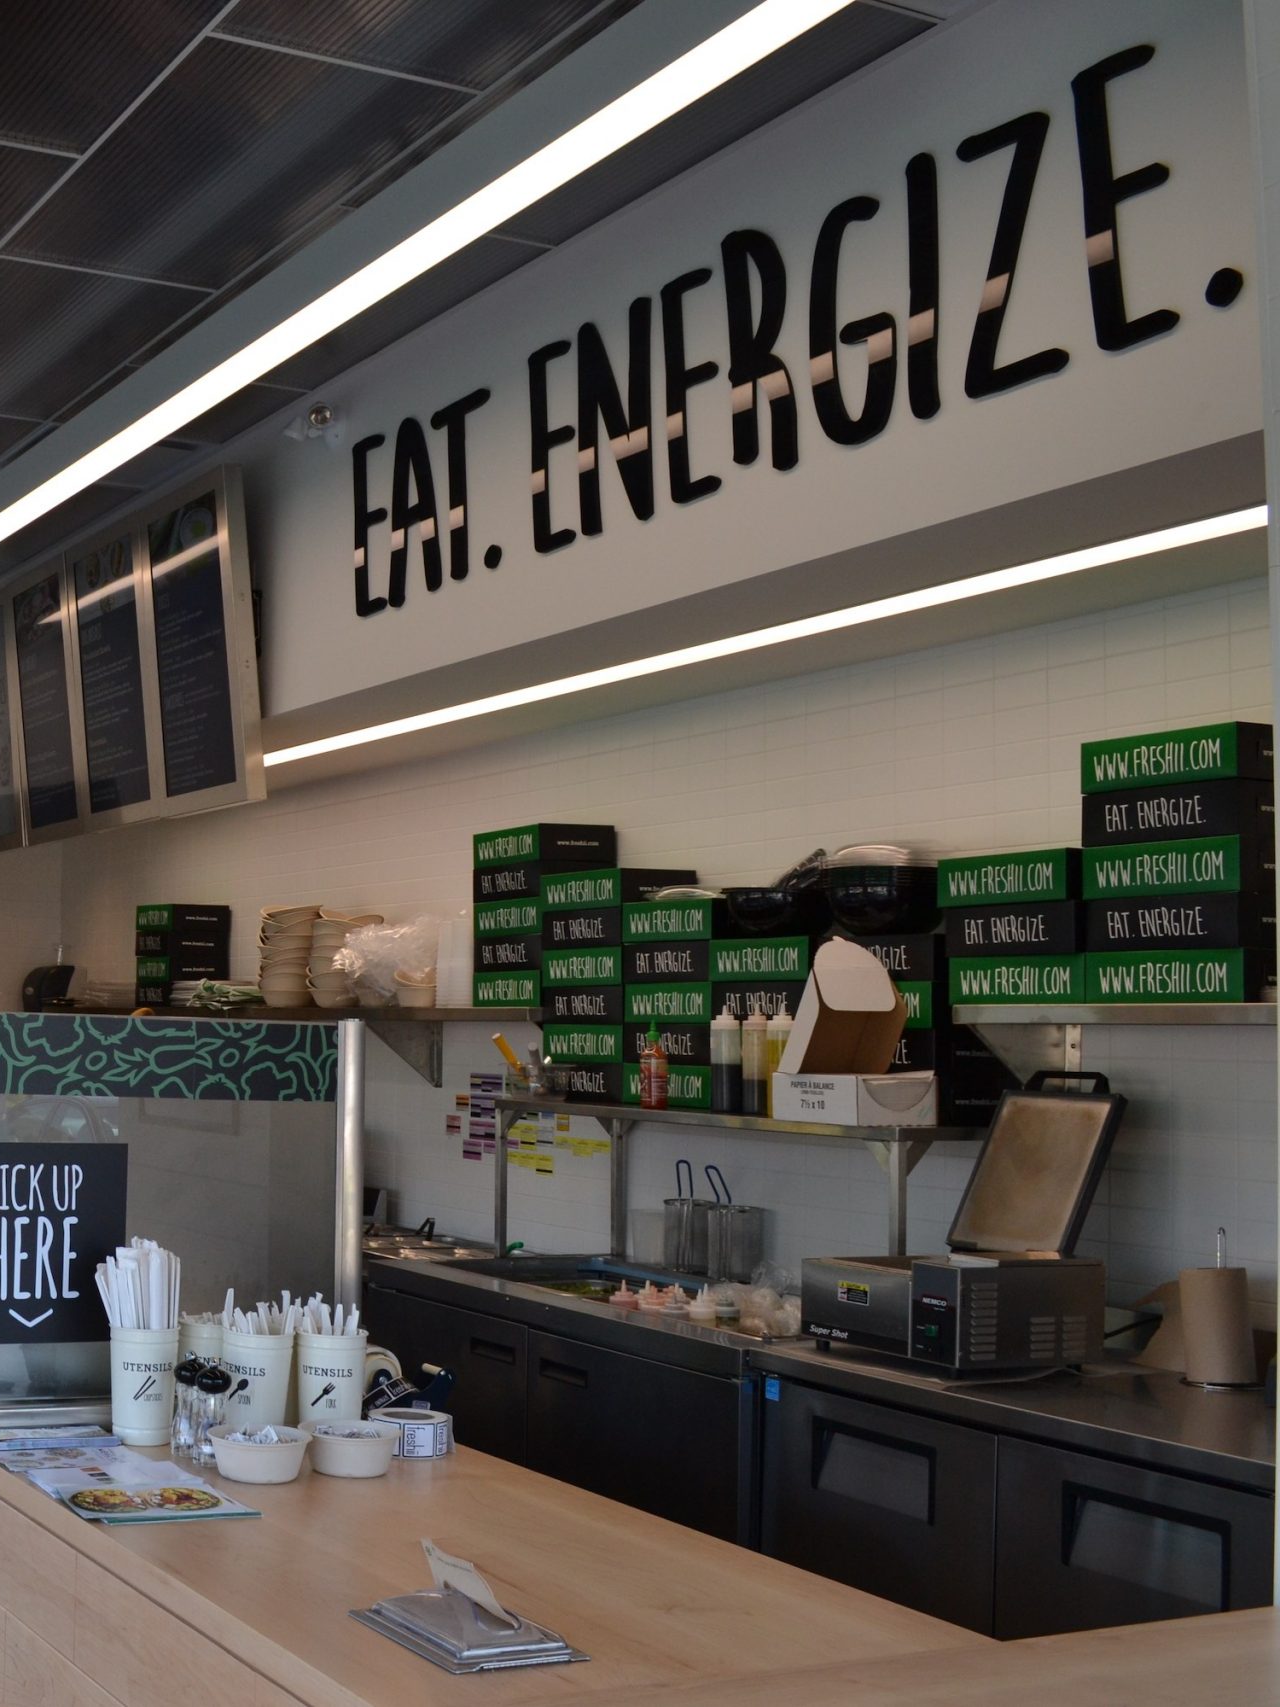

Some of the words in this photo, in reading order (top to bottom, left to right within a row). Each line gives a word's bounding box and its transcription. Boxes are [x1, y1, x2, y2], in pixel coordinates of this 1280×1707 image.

[352, 388, 503, 618] EAT.
[528, 44, 1244, 554] ENERGIZE.
[1093, 737, 1221, 783] WWW.FRESHII.COM
[1105, 804, 1133, 832] EAT.
[1136, 795, 1207, 830] ENERGIZE.
[478, 834, 533, 862] WWW.FRESHII.COM
[948, 861, 1053, 898] WWW.FRESHII.COM
[1095, 850, 1224, 889] WWW.FRESHII.COM
[546, 877, 614, 905] WWW.FRESHII.COM
[478, 906, 537, 931] WWW.FRESHII.COM
[629, 908, 703, 934] WWW.FRESHII.COM
[964, 918, 988, 945] EAT.
[990, 914, 1049, 943] ENERGIZE.
[1107, 911, 1135, 939] EAT.
[1138, 906, 1208, 938] ENERGIZE.
[548, 955, 614, 980] WWW.FRESHII.COM
[636, 952, 653, 974] EAT.
[654, 950, 694, 973] ENERGIZE.
[716, 946, 800, 973] WWW.FRESHII.COM
[477, 978, 533, 1001] WWW.FRESHII.COM
[959, 965, 1070, 996] WWW.FRESHII.COM
[1099, 962, 1227, 995] WWW.FRESHII.COM
[631, 991, 703, 1016] WWW.FRESHII.COM
[549, 1032, 615, 1056] WWW.FRESHII.COM
[659, 1032, 694, 1055] NERGIZE.
[52, 1164, 83, 1212] UP
[809, 1324, 831, 1336] Super
[831, 1328, 849, 1340] Shot
[122, 1362, 173, 1373] UTENSILS
[224, 1361, 266, 1377] TENSILS
[302, 1365, 353, 1378] UTENSILS
